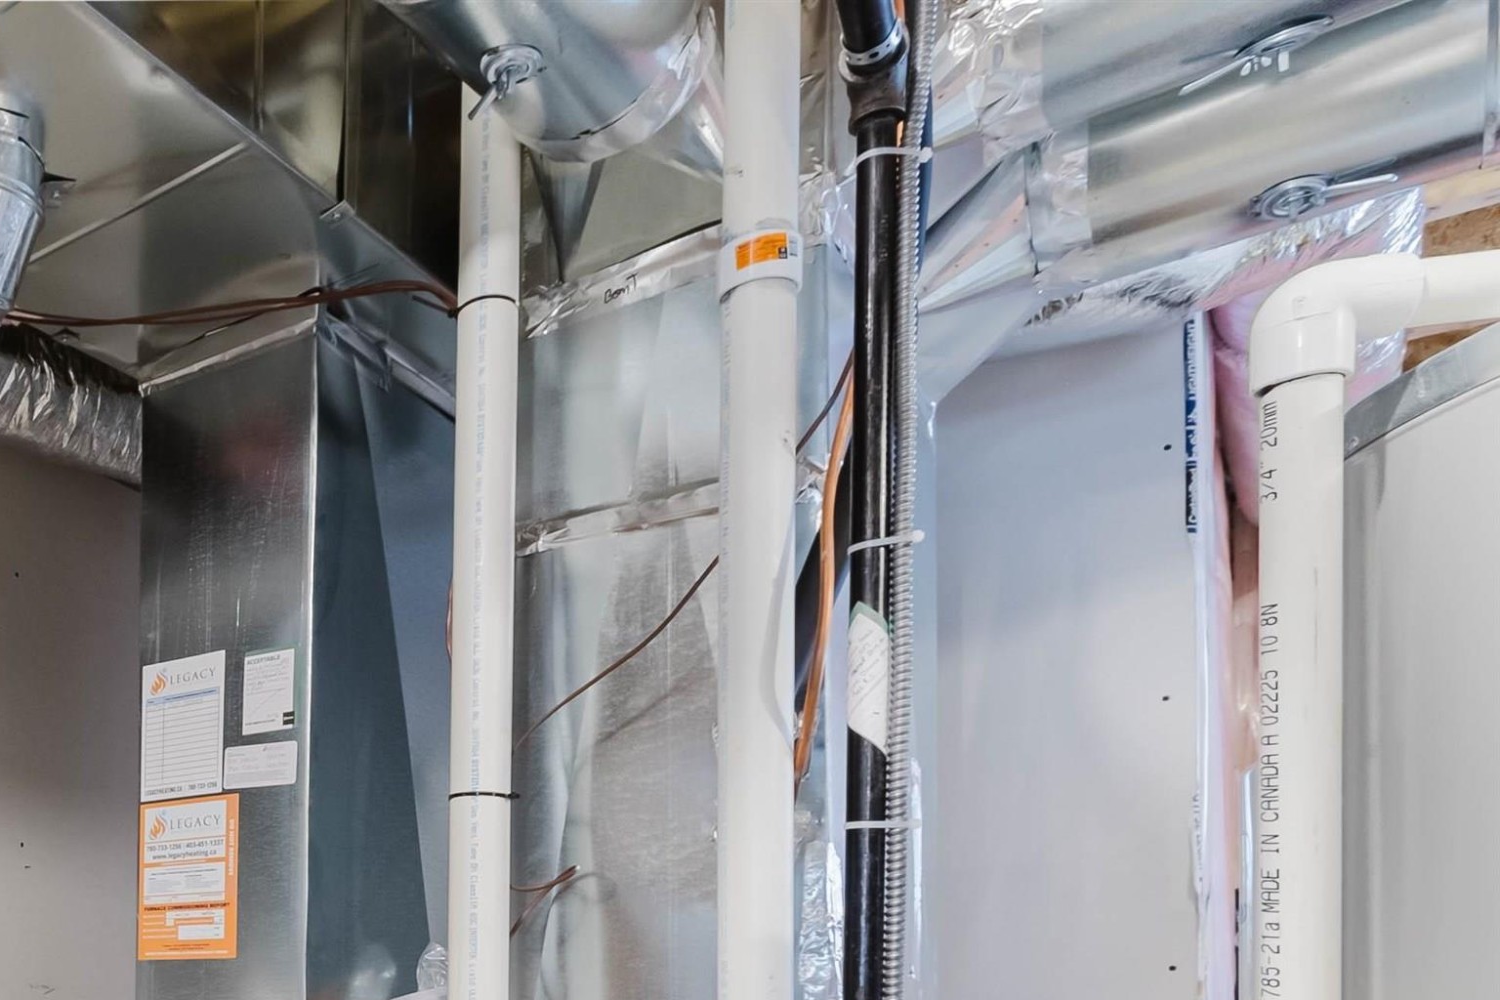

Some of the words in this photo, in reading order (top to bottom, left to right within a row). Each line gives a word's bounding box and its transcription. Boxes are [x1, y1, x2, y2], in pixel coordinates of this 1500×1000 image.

[1260, 401, 1278, 448] 20mm
[1260, 603, 1278, 626] 8N
[1260, 635, 1278, 655] 10
[170, 666, 216, 685] LEGACY
[1260, 670, 1279, 725] 02225
[1260, 734, 1279, 746] A
[1260, 754, 1279, 822] CANADA
[170, 814, 220, 830] LEGACY
[1260, 835, 1279, 854] IN
[1260, 868, 1279, 914] MADE
